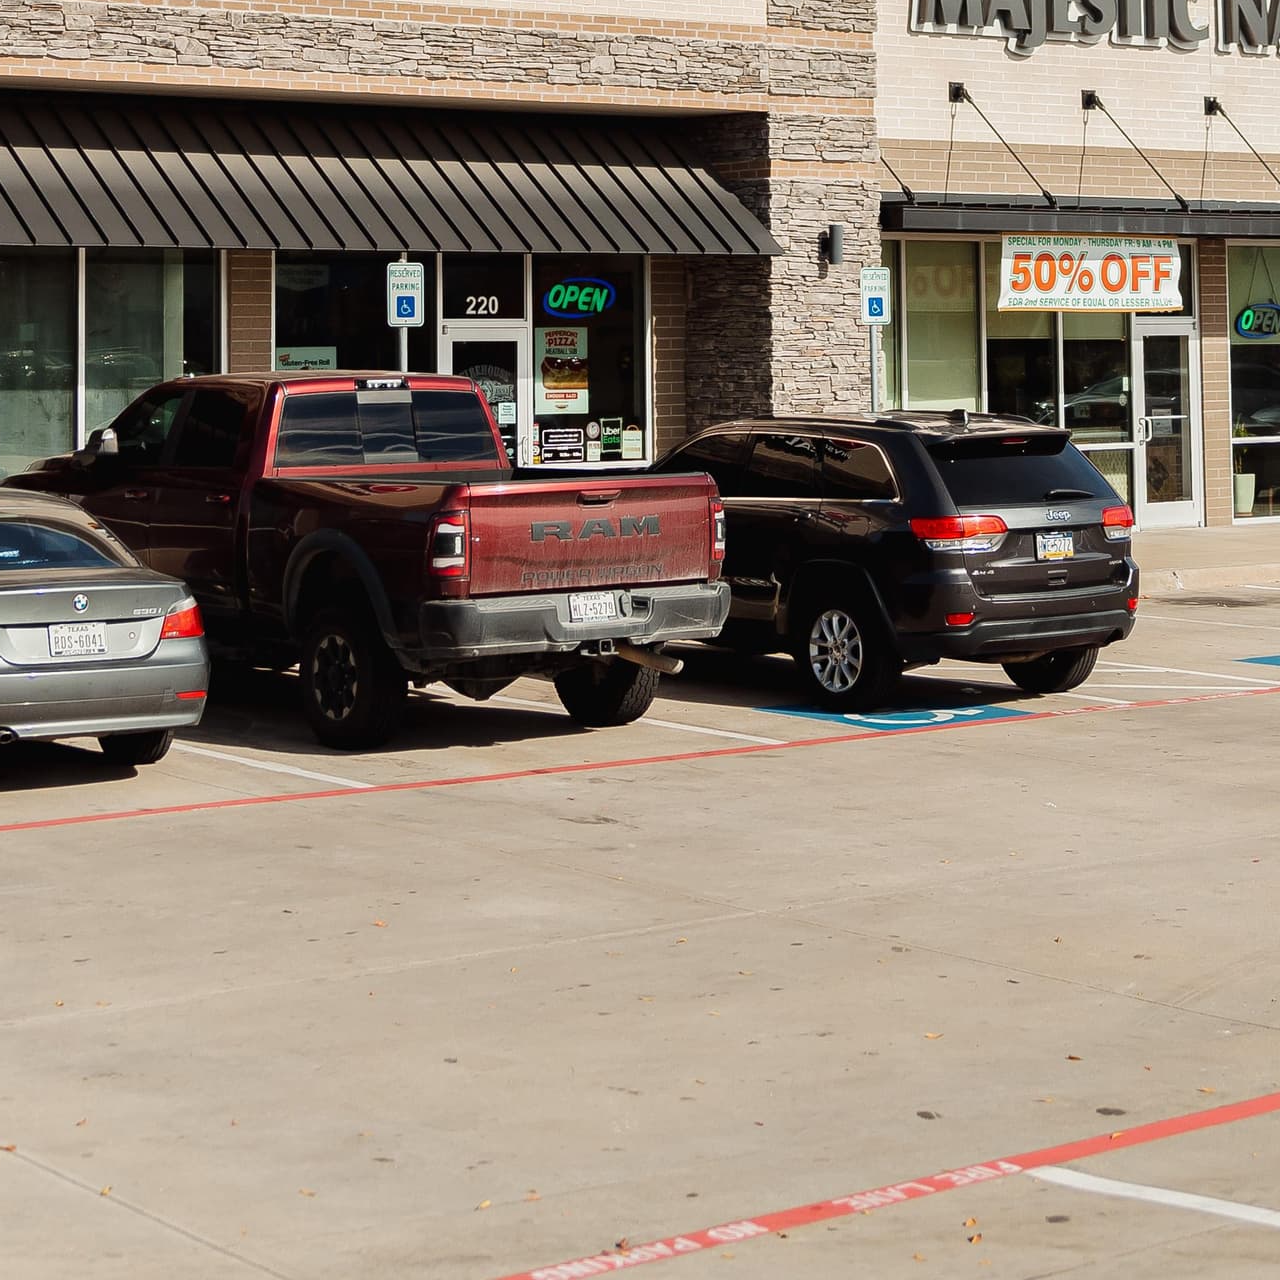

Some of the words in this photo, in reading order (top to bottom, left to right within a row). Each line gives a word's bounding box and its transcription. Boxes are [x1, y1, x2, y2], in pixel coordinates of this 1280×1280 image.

[1007, 236, 1036, 246] SPECIAL
[1038, 237, 1051, 246] FOR
[1053, 237, 1082, 246] MONDAY
[1087, 238, 1123, 248] THURSDAY
[1142, 239, 1153, 248] AM
[1163, 239, 1173, 249] PM
[390, 269, 421, 278] RESERVED
[1009, 250, 1096, 294] 50%
[1101, 252, 1174, 294] OFF
[391, 282, 420, 291] PARKING
[548, 284, 609, 312] OPEN
[1039, 297, 1070, 307] SERVICE
[1071, 298, 1081, 307] OF
[1083, 298, 1107, 307] EQUAL
[1108, 298, 1120, 307] OR
[1121, 298, 1150, 307] LESSER
[465, 295, 499, 315] 220
[547, 337, 576, 347] PIZZA
[602, 426, 620, 435] Uber
[602, 436, 619, 444] Eats
[1045, 509, 1071, 521] Jeep
[530, 515, 661, 542] RAM
[522, 569, 591, 583] POWER
[67, 625, 89, 633] TEXAS
[933, 1159, 1023, 1188] FIRE
[831, 1181, 936, 1213] LANE
[705, 1219, 770, 1244] NO
[529, 1235, 702, 1280] PARKING
